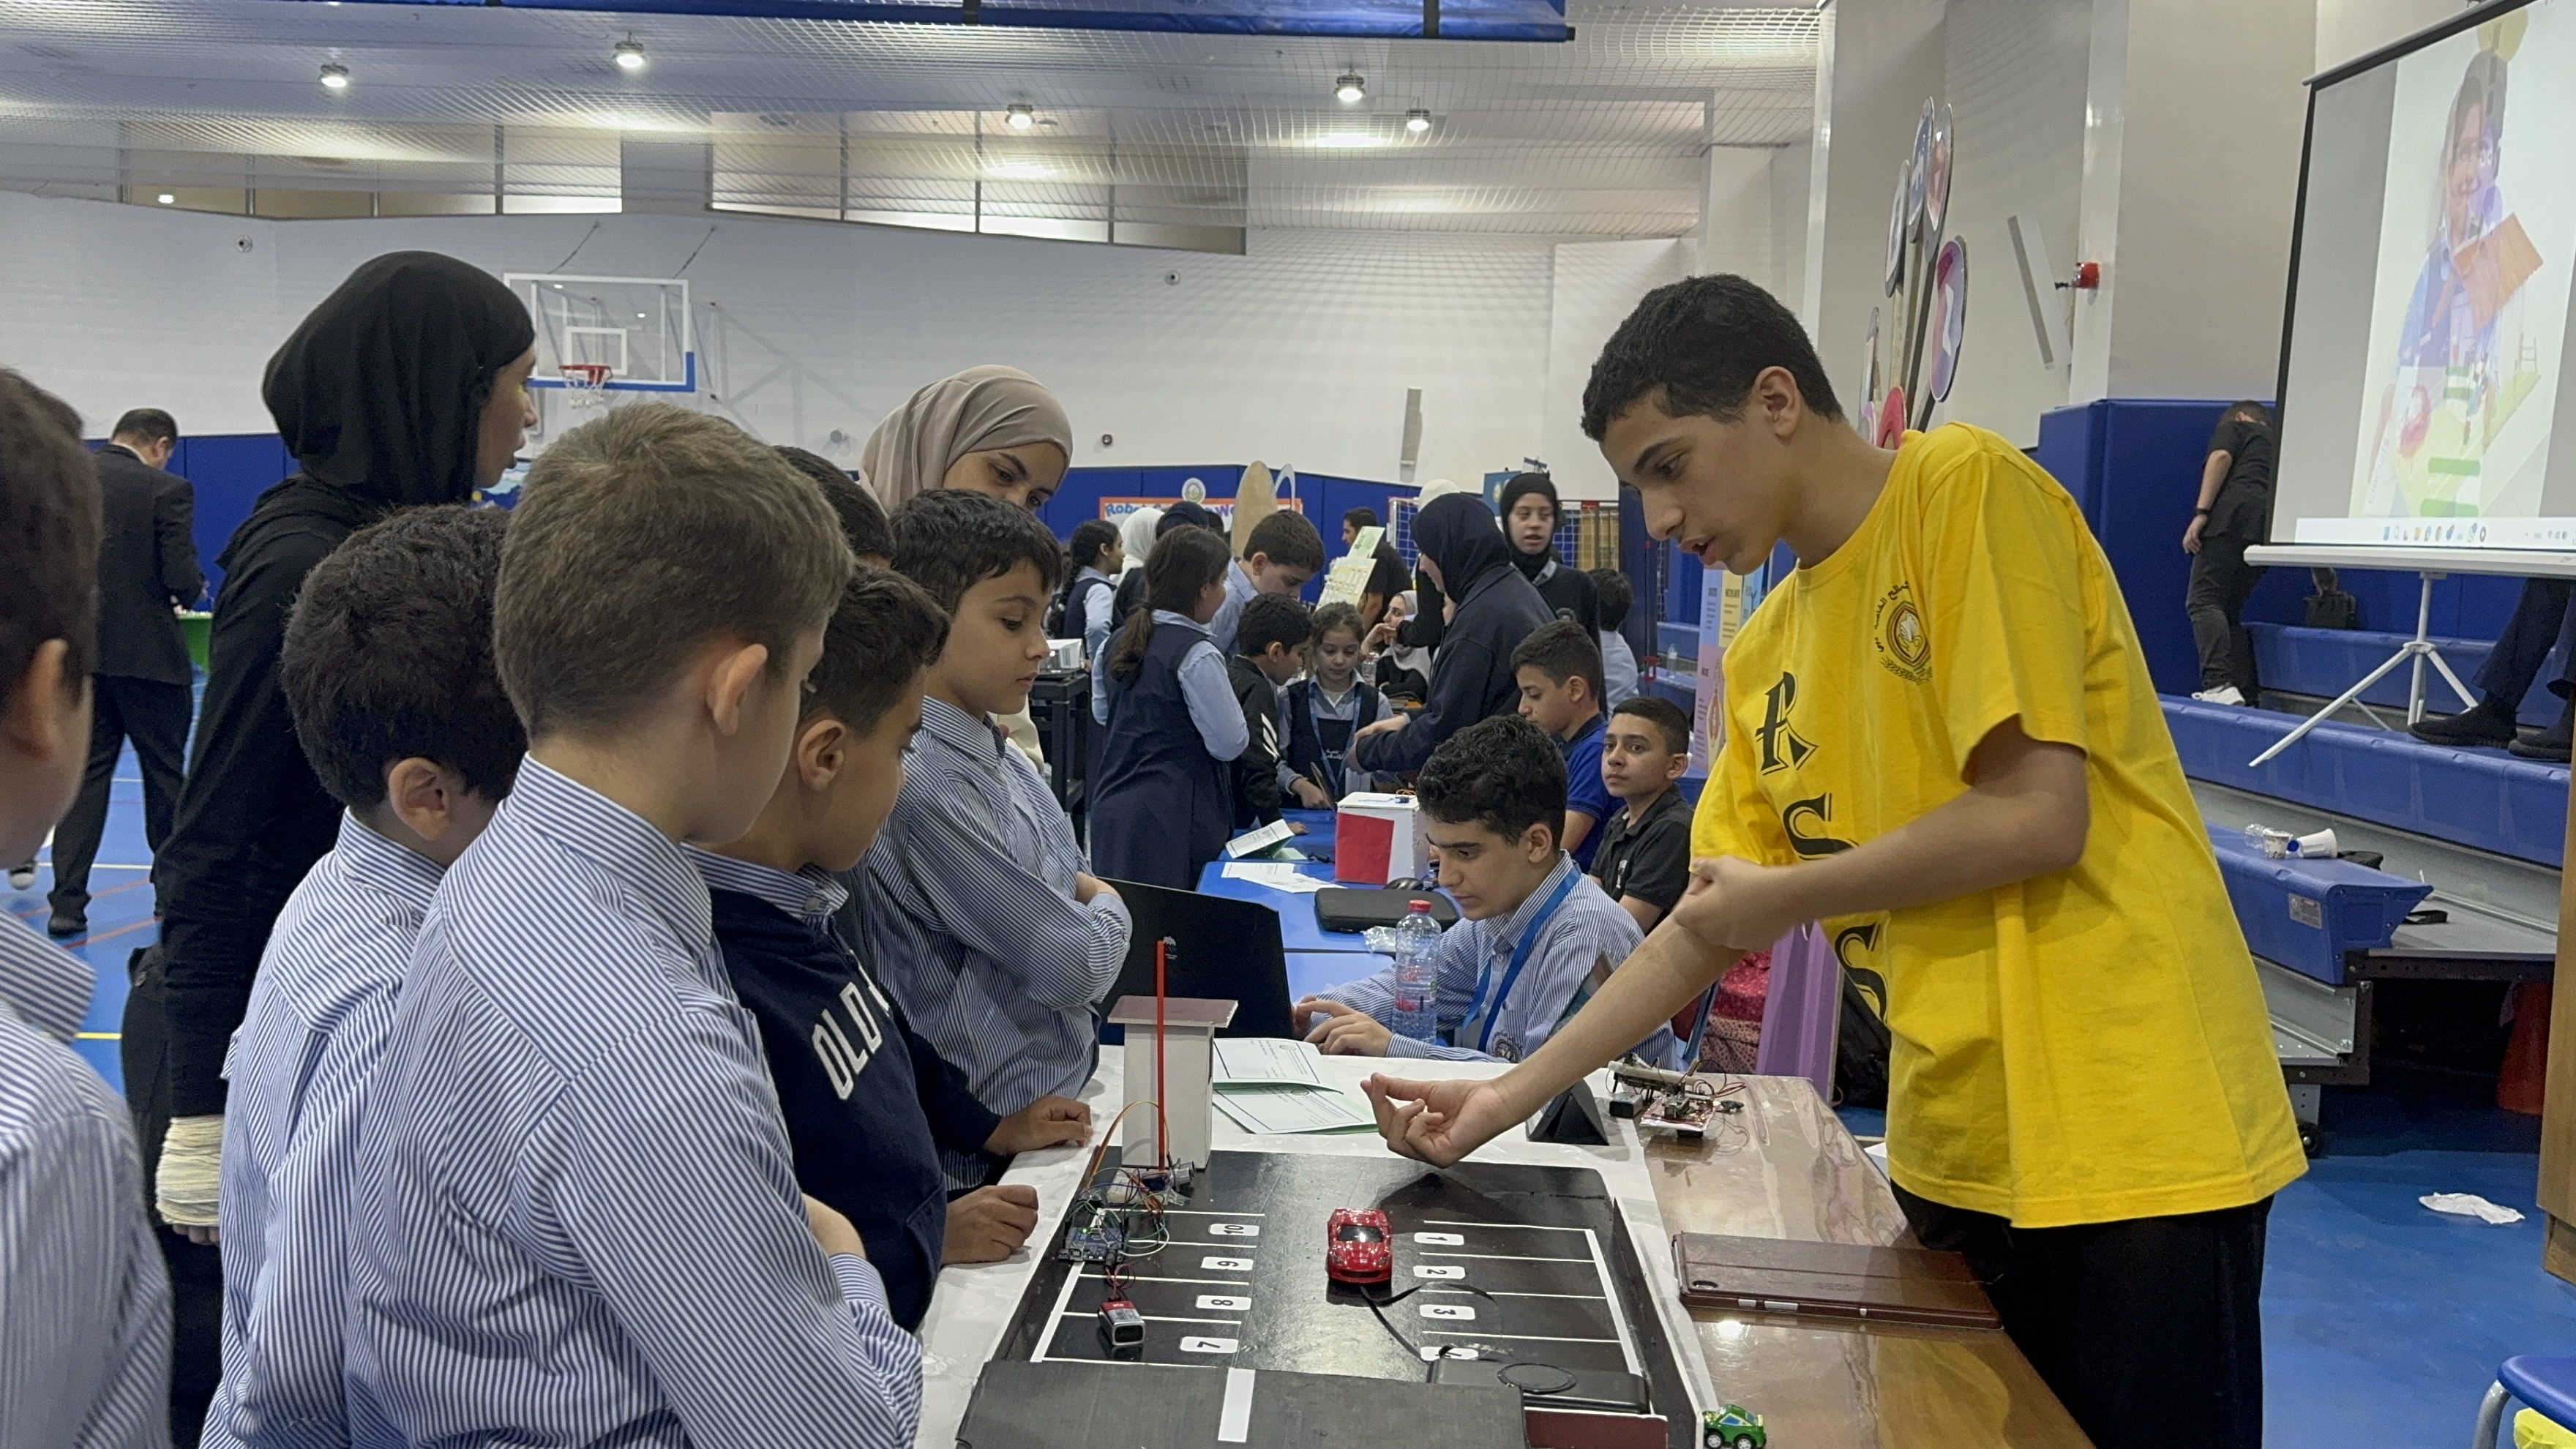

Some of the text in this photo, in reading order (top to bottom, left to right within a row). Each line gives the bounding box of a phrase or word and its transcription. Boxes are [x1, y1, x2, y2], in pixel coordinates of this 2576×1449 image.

[812, 981, 883, 1100] OLD
[1223, 1224, 1244, 1235] 10
[1197, 1341, 1221, 1349] 7
